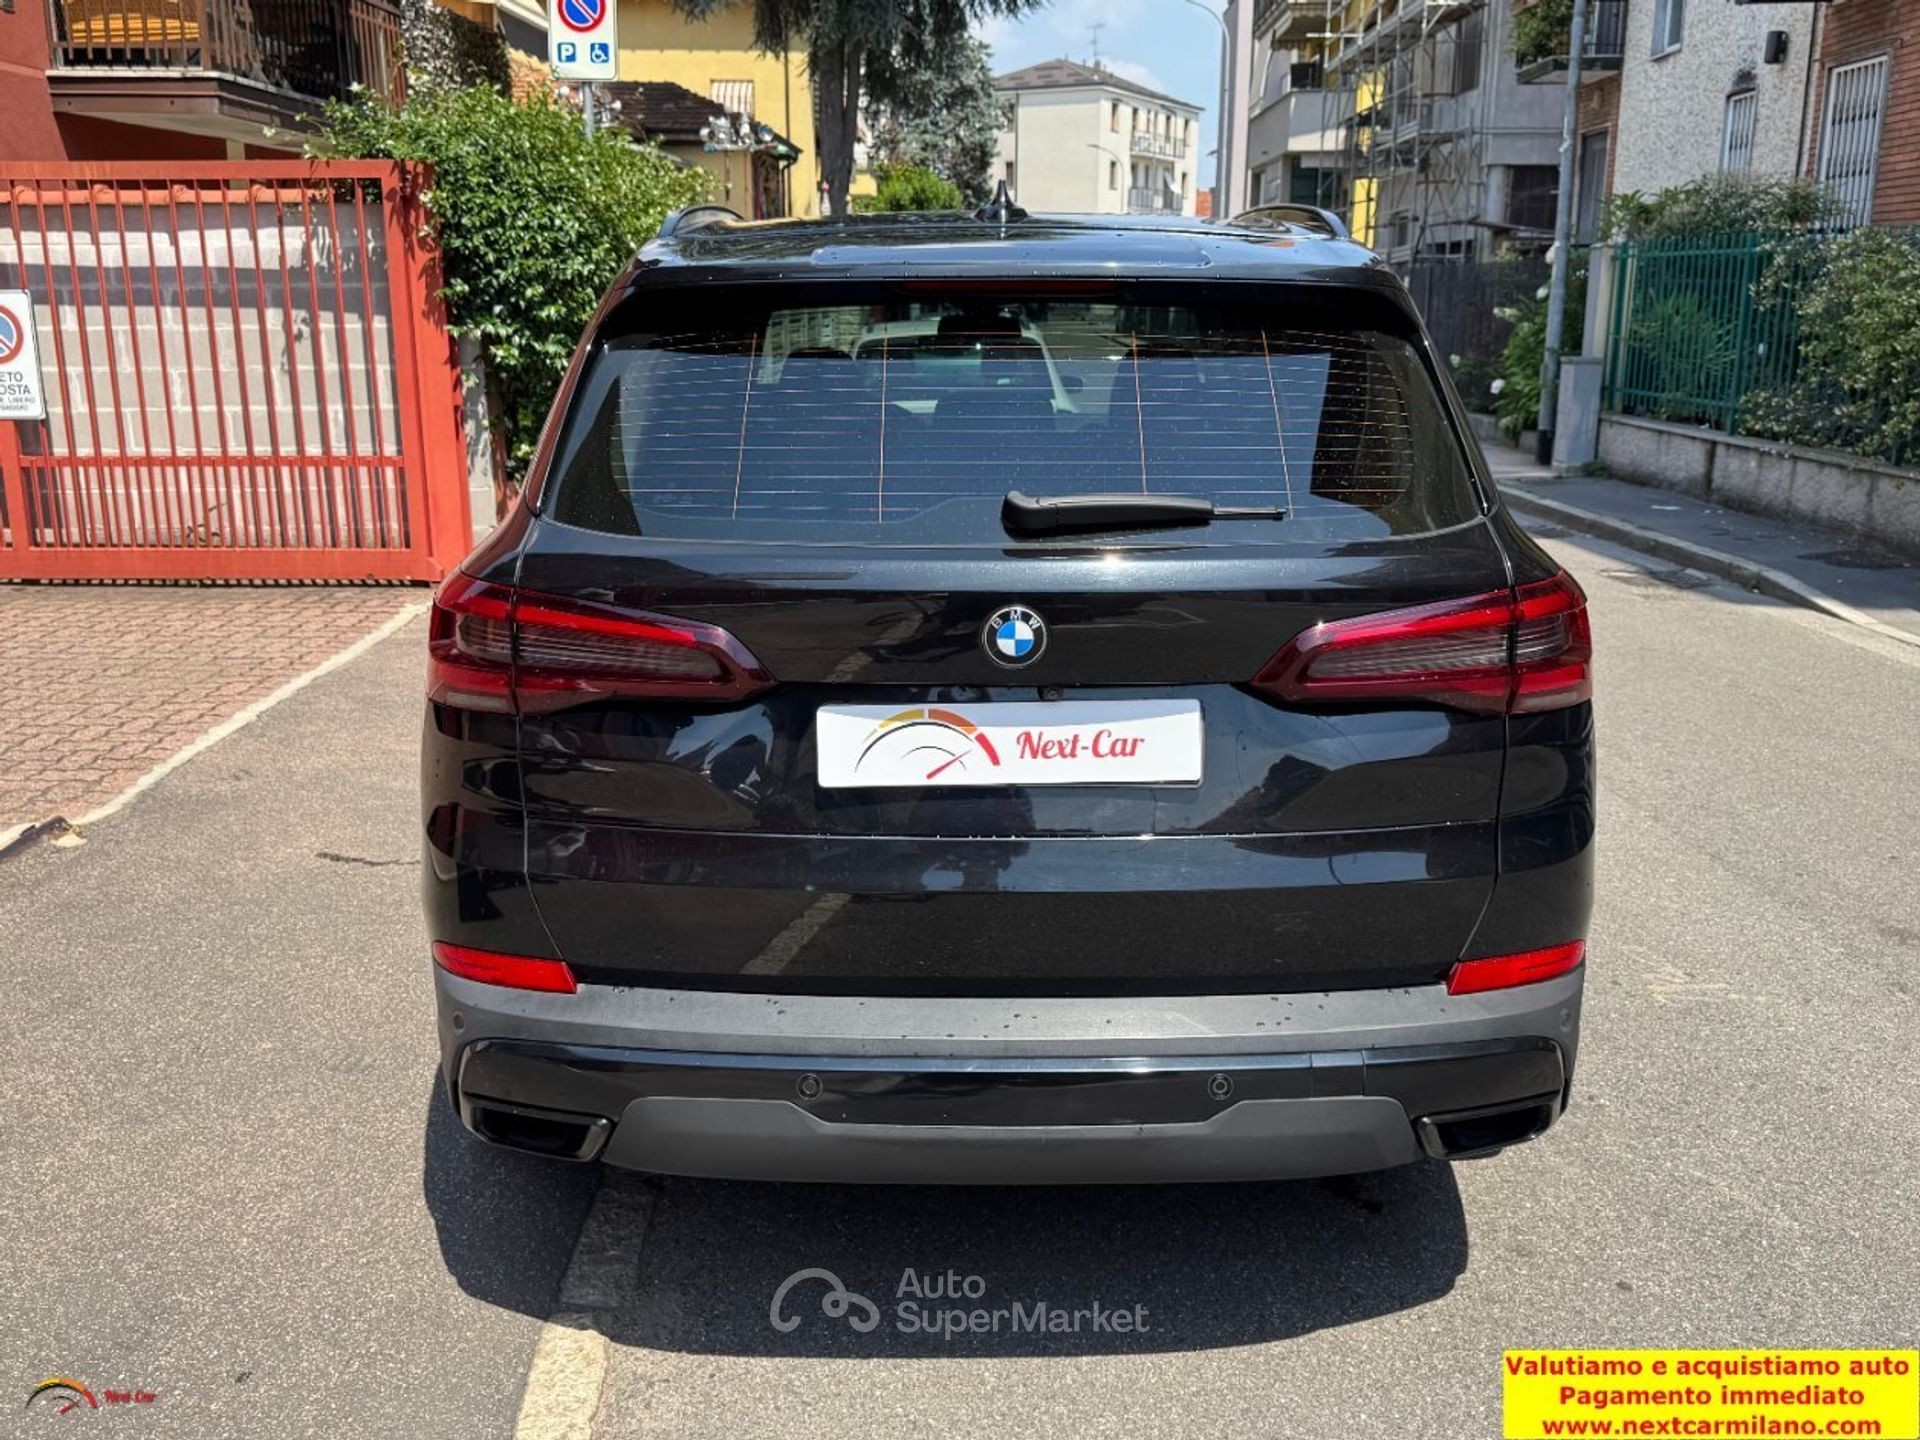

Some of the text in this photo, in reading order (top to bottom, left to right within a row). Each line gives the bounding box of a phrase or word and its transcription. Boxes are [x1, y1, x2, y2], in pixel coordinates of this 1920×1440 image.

[560, 44, 574, 61] P
[991, 609, 1041, 629] BMW
[1016, 729, 1145, 760] Next-Car
